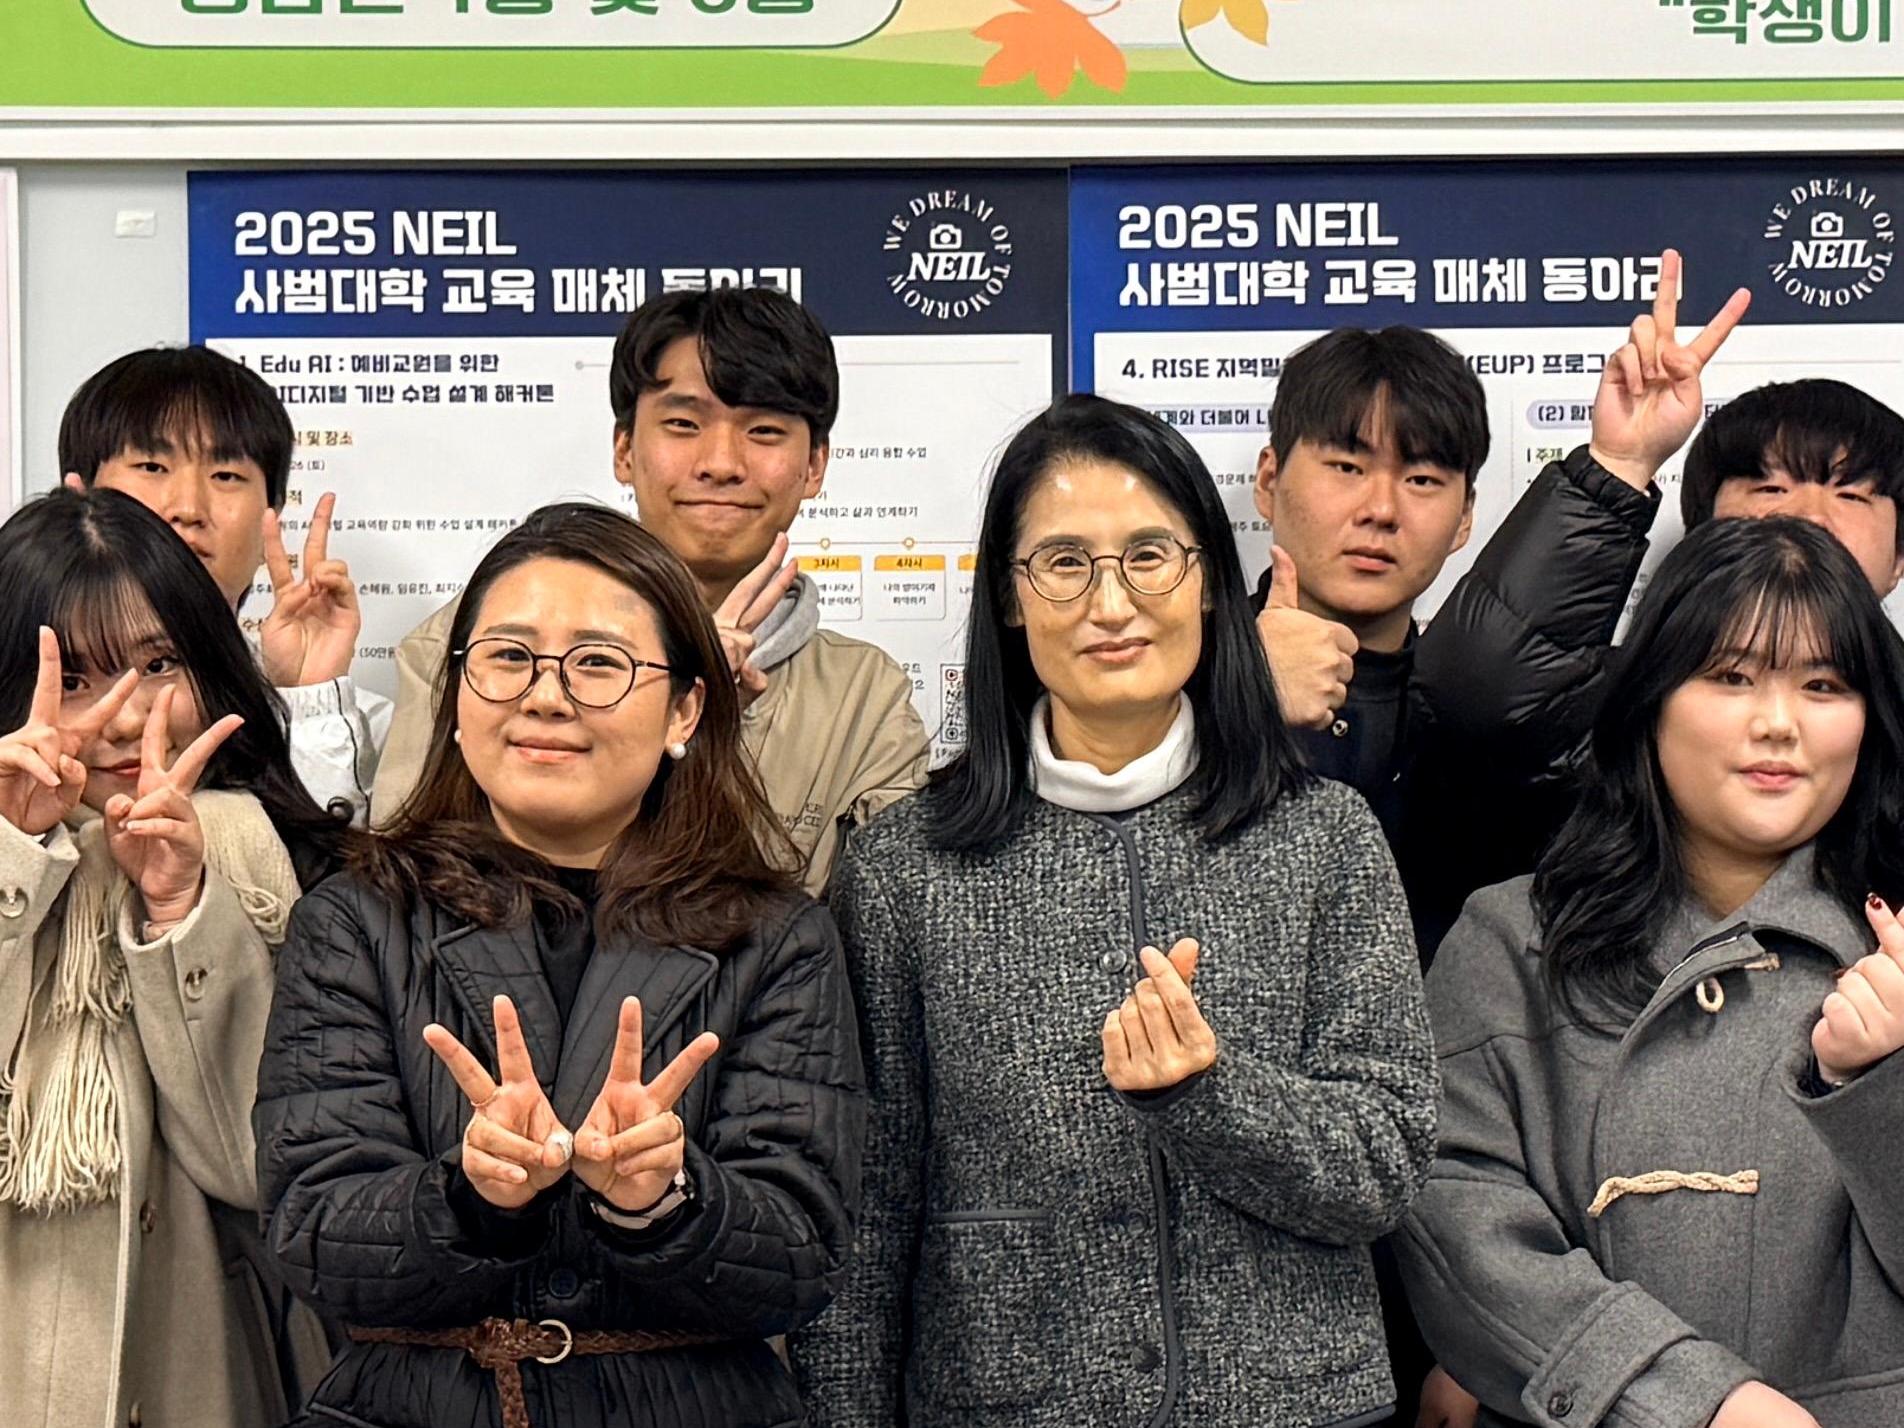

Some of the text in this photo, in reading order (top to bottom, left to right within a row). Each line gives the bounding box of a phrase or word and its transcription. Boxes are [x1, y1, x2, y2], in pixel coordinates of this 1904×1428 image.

[882, 214, 911, 250] WE
[908, 190, 994, 223] DREAM
[990, 224, 1013, 256] OF
[1118, 202, 1399, 250] 2025 NEIL
[1764, 203, 1792, 239] WE
[1790, 178, 1876, 209] DREAM
[1872, 212, 1895, 243] OF
[233, 210, 518, 256] 2025 NEIL
[905, 251, 992, 282] NEIL
[1786, 239, 1874, 270] NEIL
[234, 268, 428, 315] 사범대학
[442, 269, 536, 313] 교육
[551, 268, 647, 314] 매체
[1118, 261, 1310, 306] 사범대학
[1324, 260, 1416, 304] 교육
[1433, 259, 1527, 303] 매체
[260, 354, 302, 373] Edu
[307, 354, 335, 373] AI
[460, 355, 499, 373] 위한
[1122, 358, 1145, 379] 4.
[1152, 358, 1210, 378] RISE
[355, 385, 395, 403] 기반
[402, 385, 440, 403] 수업
[449, 385, 487, 403] 설계
[495, 385, 554, 403] 해커톤
[1200, 410, 1249, 426] 더불어
[1537, 403, 1565, 422] (2)
